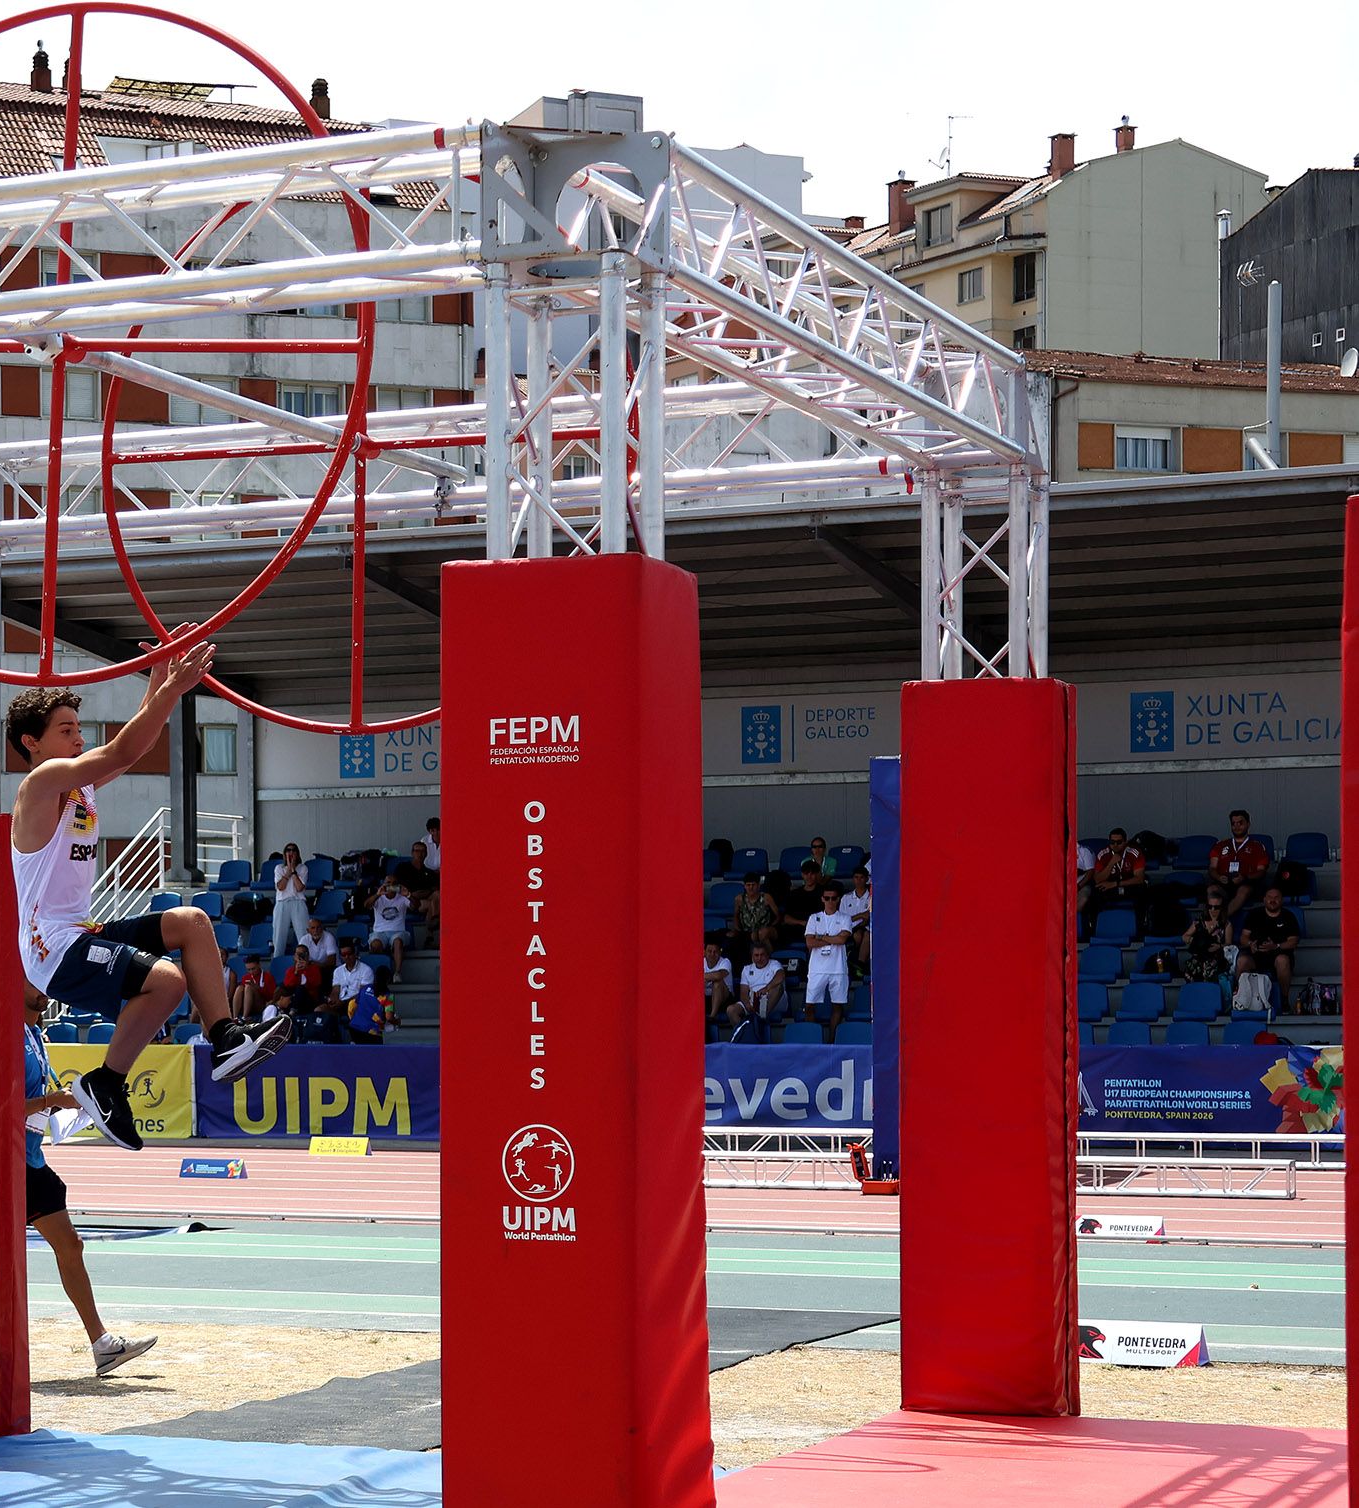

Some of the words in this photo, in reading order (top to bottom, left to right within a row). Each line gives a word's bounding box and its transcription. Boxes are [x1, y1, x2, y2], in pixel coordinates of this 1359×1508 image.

[1186, 691, 1287, 717] XUNTA
[806, 707, 875, 722] DEPORTE
[385, 725, 440, 747] XUN
[489, 715, 580, 745] FEPM
[805, 725, 869, 740] GALEGO
[1186, 723, 1221, 745] DE
[490, 747, 538, 755] FEDERACIÓN
[539, 745, 580, 754] ESPAÑOLA
[384, 753, 423, 772] DE
[536, 754, 580, 764] MODERNO
[523, 801, 547, 1090] OBSTACLES
[1104, 1078, 1162, 1088] PENTATHLON
[1104, 1089, 1120, 1098] U17
[1120, 1089, 1169, 1098] EUROPEAN
[1169, 1090, 1243, 1099] CHAMPIONSHIPS
[1244, 1091, 1251, 1099] &
[233, 1076, 412, 1136] UIPM
[1104, 1100, 1184, 1109] PARATETRATHLON
[1185, 1100, 1219, 1109] WORLD
[1219, 1101, 1252, 1110] SERIES
[1104, 1111, 1164, 1120] PONTEVEDRA,
[1166, 1111, 1191, 1120] SPAIN
[1192, 1111, 1214, 1120] 2026
[502, 1206, 577, 1232] UIPM
[1109, 1224, 1153, 1232] PONTEVEDRA
[504, 1231, 530, 1240] World
[530, 1232, 577, 1242] Pentathlon
[1117, 1336, 1186, 1349] PONTEVEDRA
